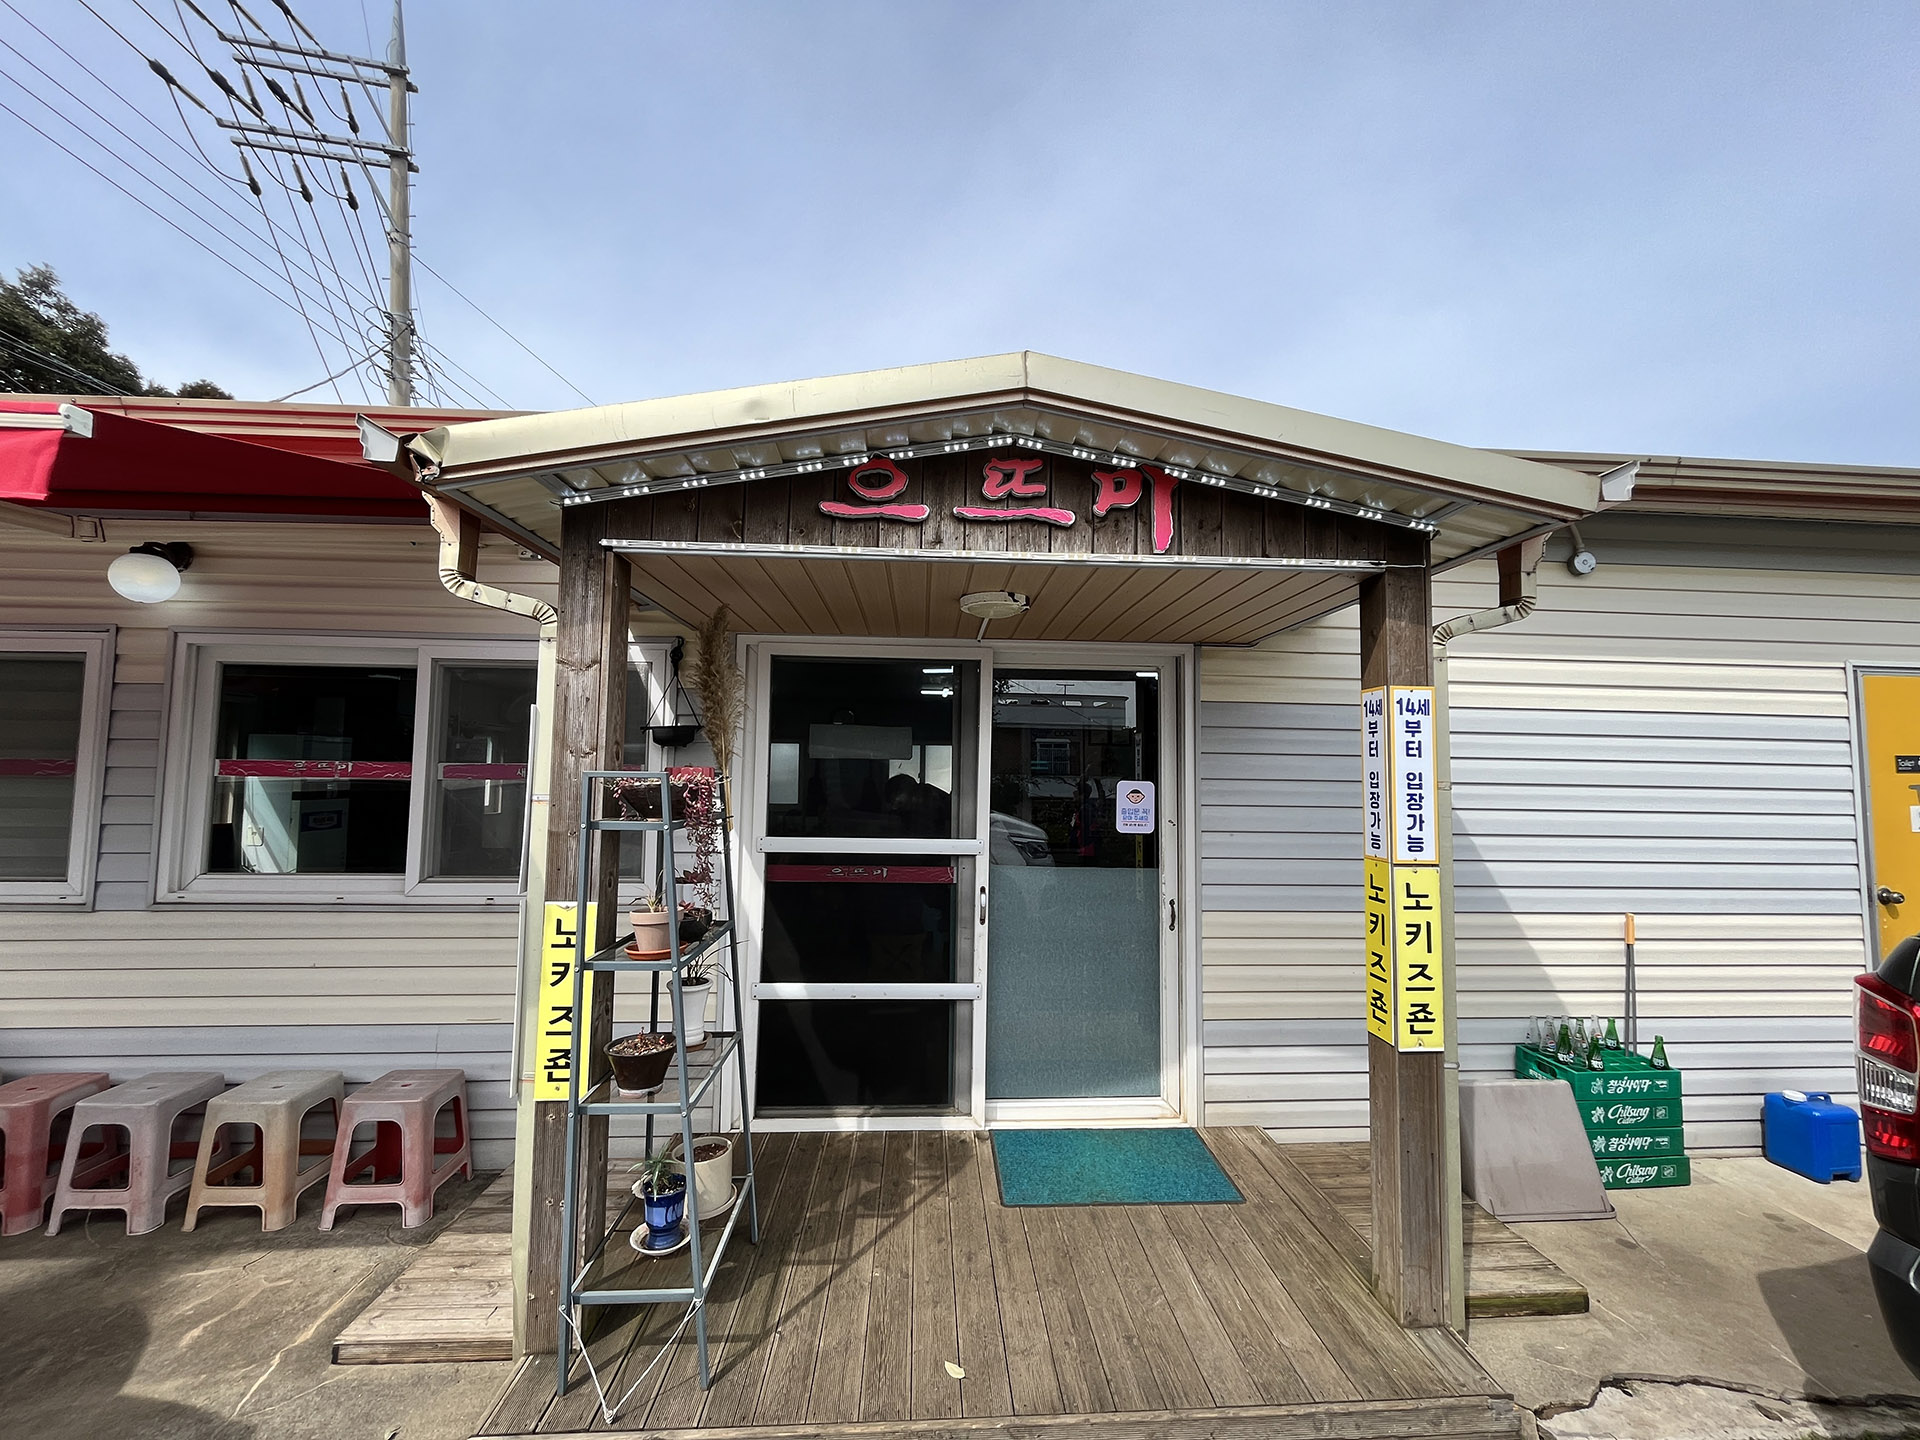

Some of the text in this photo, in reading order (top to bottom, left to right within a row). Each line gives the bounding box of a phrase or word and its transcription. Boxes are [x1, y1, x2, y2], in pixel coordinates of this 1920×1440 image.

[818, 457, 1179, 553] 으뜨미
[1363, 698, 1383, 850] 14세부터 입장가능
[1396, 697, 1430, 853] 14세부터 입장가능
[1368, 873, 1388, 1025] 노키즈죤
[1402, 882, 1436, 1035] 노키즈죤
[1607, 1076, 1652, 1094] 칠성사이다
[1608, 1104, 1650, 1122] Chilsung
[1608, 1134, 1653, 1152] 칠성사이다
[1616, 1163, 1658, 1181] Chilsung
